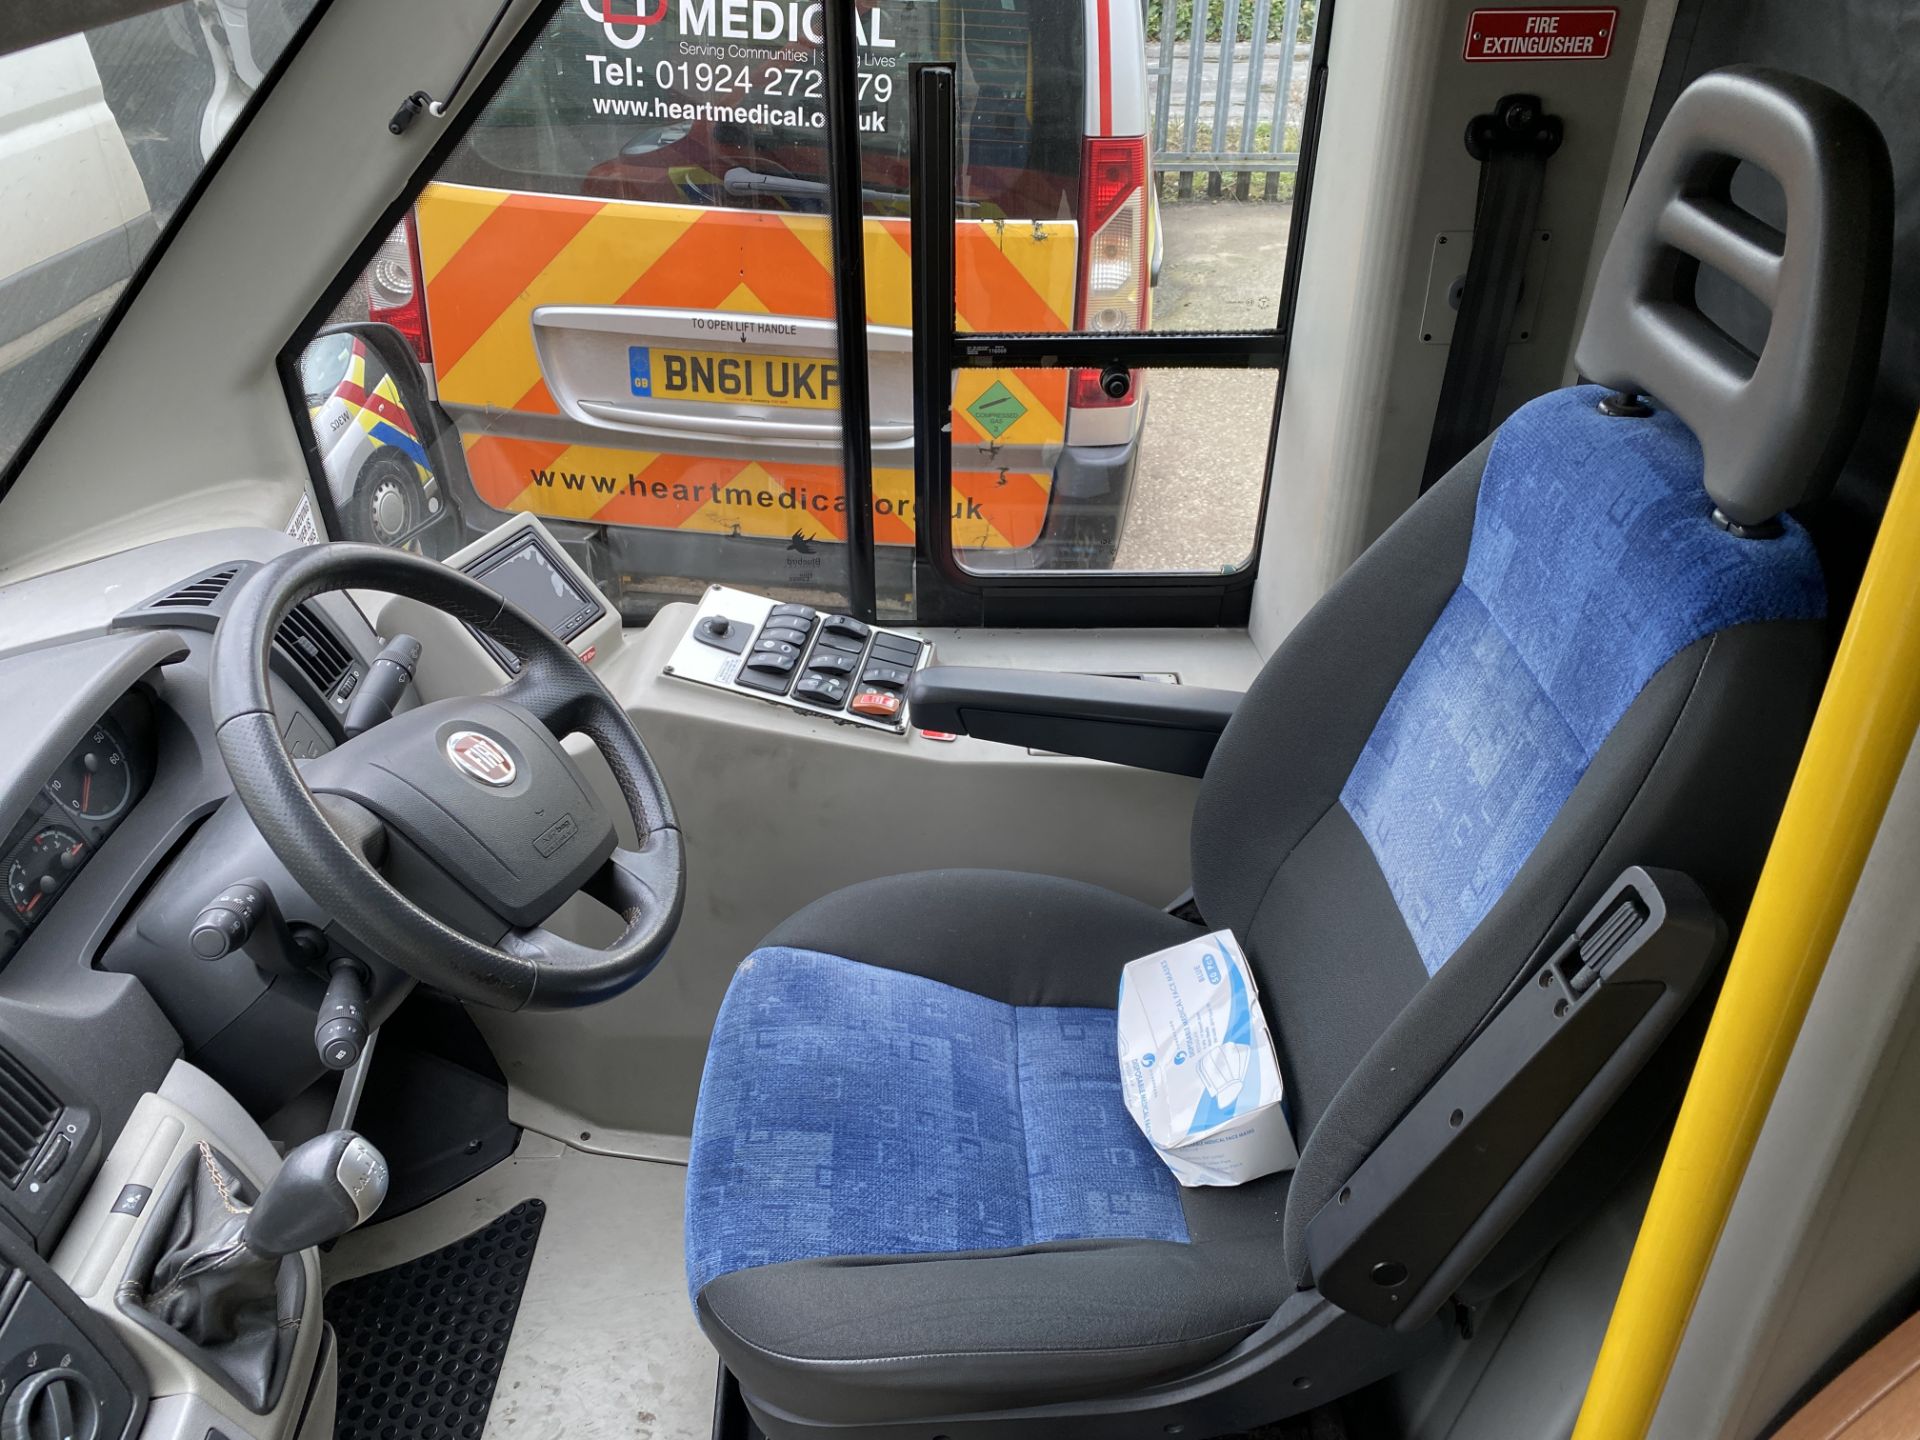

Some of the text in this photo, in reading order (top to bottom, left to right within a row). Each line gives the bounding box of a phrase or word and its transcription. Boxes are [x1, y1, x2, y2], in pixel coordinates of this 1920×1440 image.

[1526, 17, 1560, 33] FIRE
[1483, 37, 1594, 53] EXTINGUISHER
[679, 41, 724, 60] Serving
[728, 44, 809, 63] Communities
[864, 52, 896, 68] Lives
[585, 54, 893, 103] Tel: 01924 27279
[692, 318, 797, 335] TO OPEN LIFT HANDLE
[634, 377, 648, 388] GB
[664, 354, 753, 396] BN61
[93, 731, 104, 744] 50
[109, 753, 120, 766] 60
[464, 740, 505, 773] FIAT
[51, 780, 62, 792] 10
[72, 800, 80, 809] 0
[1159, 959, 1174, 983] MASKS
[1167, 981, 1180, 1000] FACE
[1174, 998, 1189, 1027] MEDICAL
